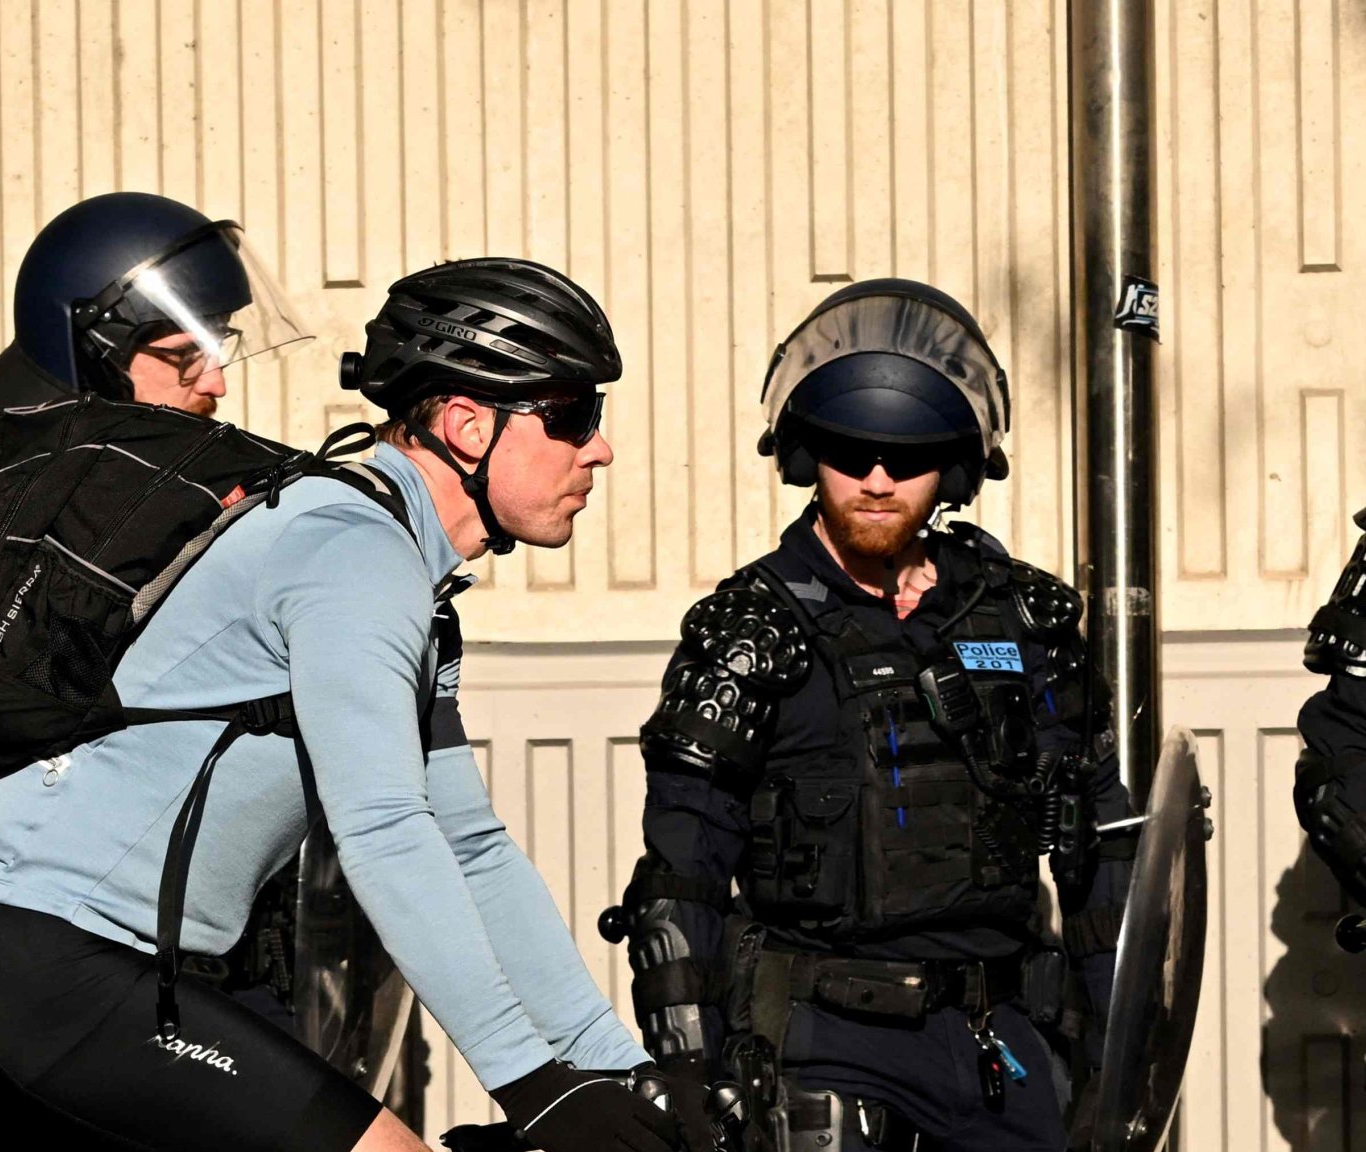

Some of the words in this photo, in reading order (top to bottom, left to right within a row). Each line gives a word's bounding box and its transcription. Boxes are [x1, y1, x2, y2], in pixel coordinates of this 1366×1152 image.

[435, 321, 477, 341] GIRO
[957, 643, 1018, 658] Police
[975, 660, 1015, 670] 201
